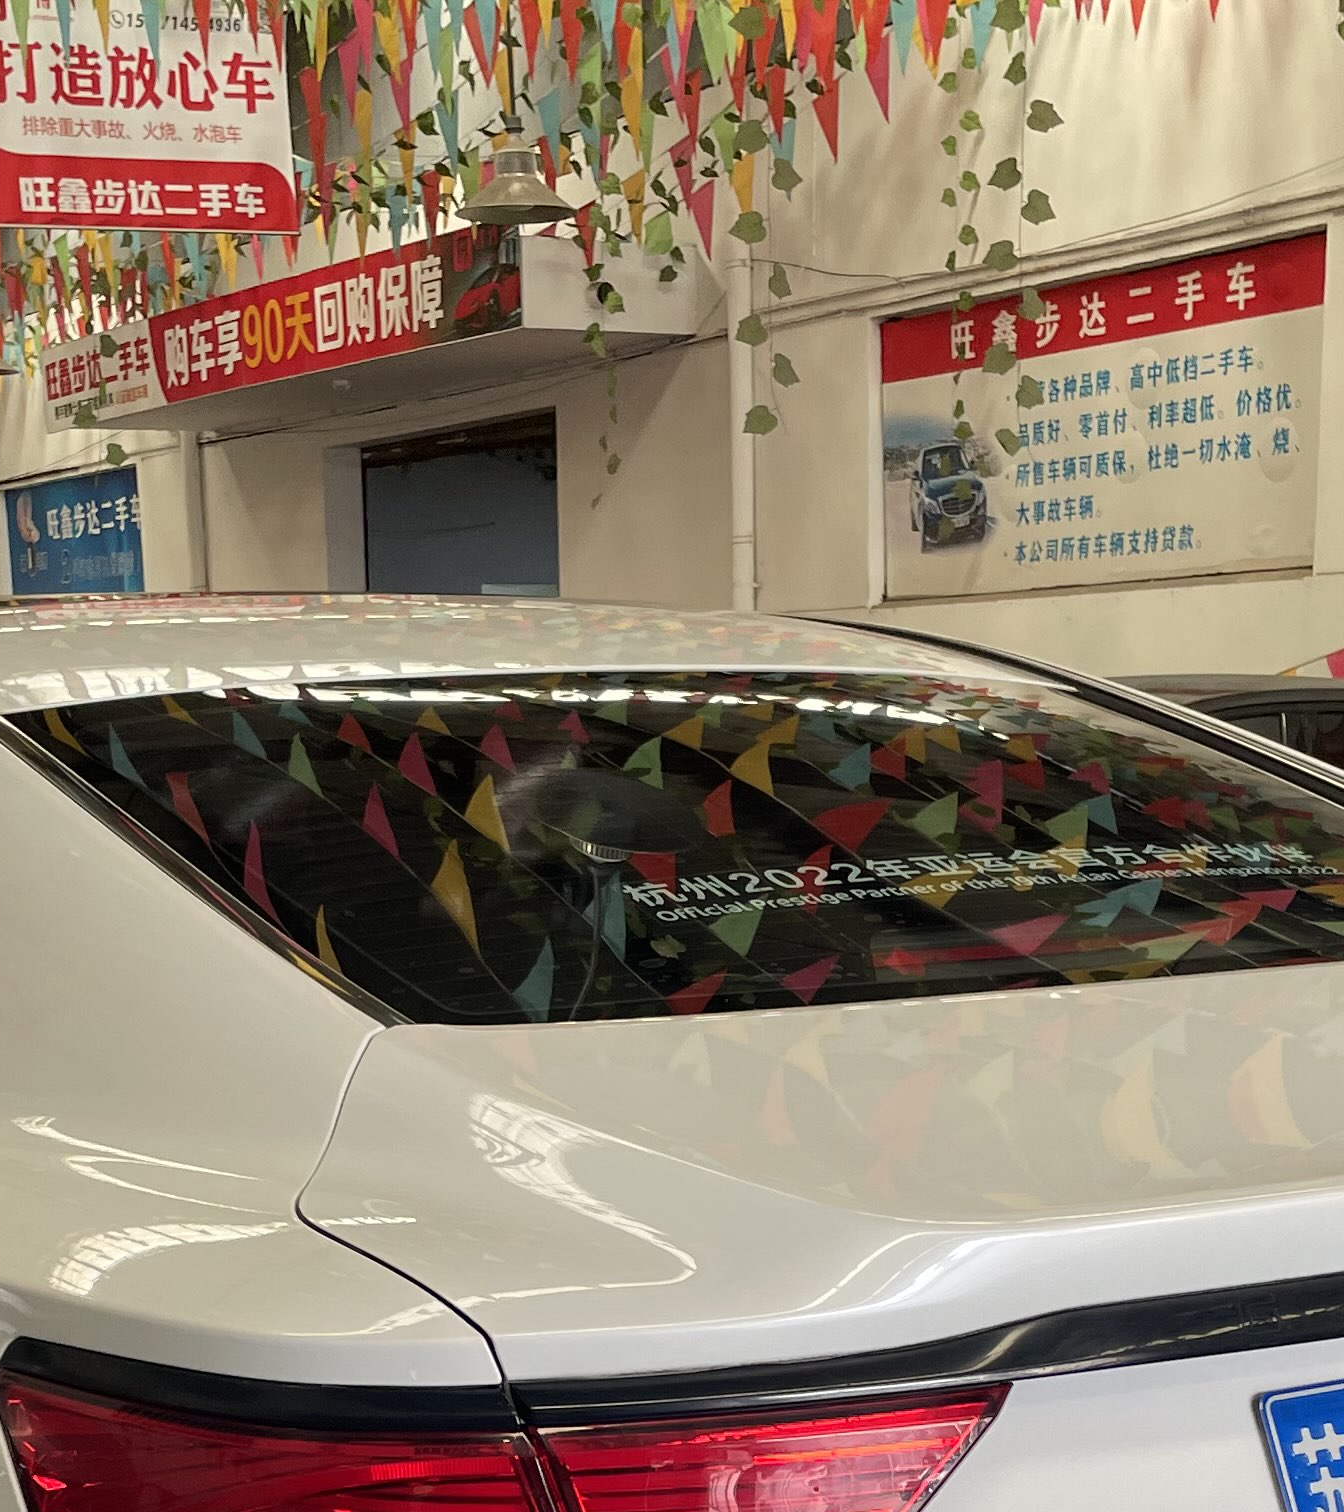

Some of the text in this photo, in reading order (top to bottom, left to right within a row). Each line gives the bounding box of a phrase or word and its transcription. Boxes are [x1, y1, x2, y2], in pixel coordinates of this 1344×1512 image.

[18, 176, 267, 218] 旺鑫步达二手车
[163, 254, 445, 389] 购车享90天回购保障
[623, 842, 1314, 907] 杭州2022年亚运会官方合作伙伴
[656, 899, 754, 922] Official
[754, 888, 852, 911] Prestige
[853, 880, 935, 901] Partner
[940, 877, 967, 893] of
[970, 873, 1009, 891] the
[1010, 871, 1056, 890] 19th
[1056, 870, 1117, 885] Asian
[1118, 867, 1189, 881] Games
[1191, 865, 1292, 880] Hangzhou
